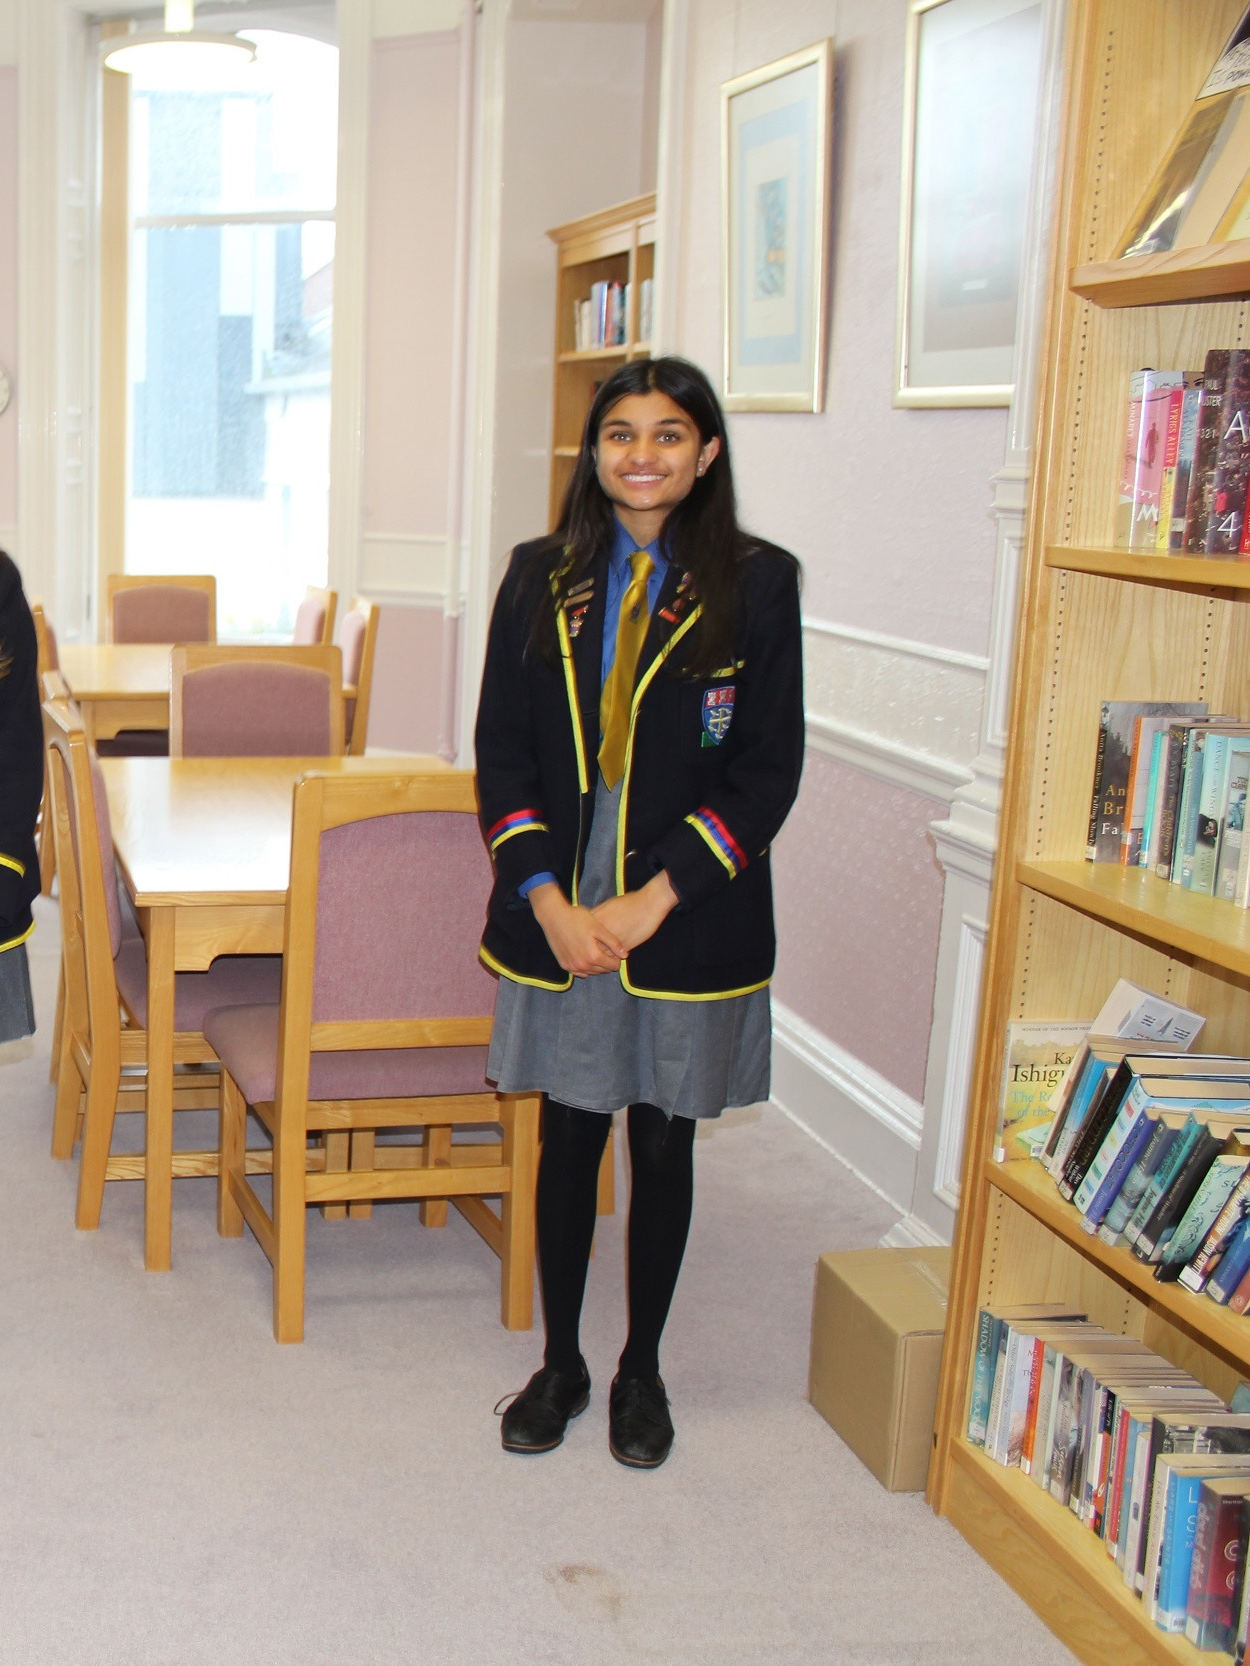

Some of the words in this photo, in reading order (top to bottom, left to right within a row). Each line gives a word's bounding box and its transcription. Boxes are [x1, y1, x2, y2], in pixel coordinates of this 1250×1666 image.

[1200, 396, 1222, 407] USTER
[1127, 401, 1136, 438] MINARET
[1168, 403, 1179, 434] LYRICS
[1223, 410, 1250, 443] A
[1166, 435, 1176, 464] ALLEY
[1099, 732, 1107, 752] Anita
[1214, 741, 1222, 771] DANCE
[1095, 754, 1104, 789] Brookner
[1105, 784, 1126, 796] An
[1209, 787, 1217, 818] WINGS
[1090, 794, 1099, 820] Falling
[1103, 801, 1124, 815] Br
[1087, 821, 1096, 846] Slowly
[1163, 810, 1173, 857] Children's
[1011, 1091, 1035, 1103] The
[1017, 1105, 1031, 1118] of
[1032, 1106, 1050, 1117] the
[1141, 1135, 1160, 1161] Joanne
[1200, 1172, 1213, 1193] SUSAN
[1139, 1189, 1158, 1213] Joanne
[1224, 1187, 1247, 1218] DYNAMITE
[1132, 1213, 1145, 1229] Har
[1213, 1215, 1230, 1236] ROOM
[1202, 1235, 1219, 1254] JASON
[979, 1314, 989, 1357] SHADOW
[978, 1360, 985, 1372] OF
[976, 1374, 984, 1392] THE
[1003, 1388, 1012, 1408] Bridge
[1194, 1502, 1211, 1551] cloud
[1190, 1548, 1205, 1589] atlas
